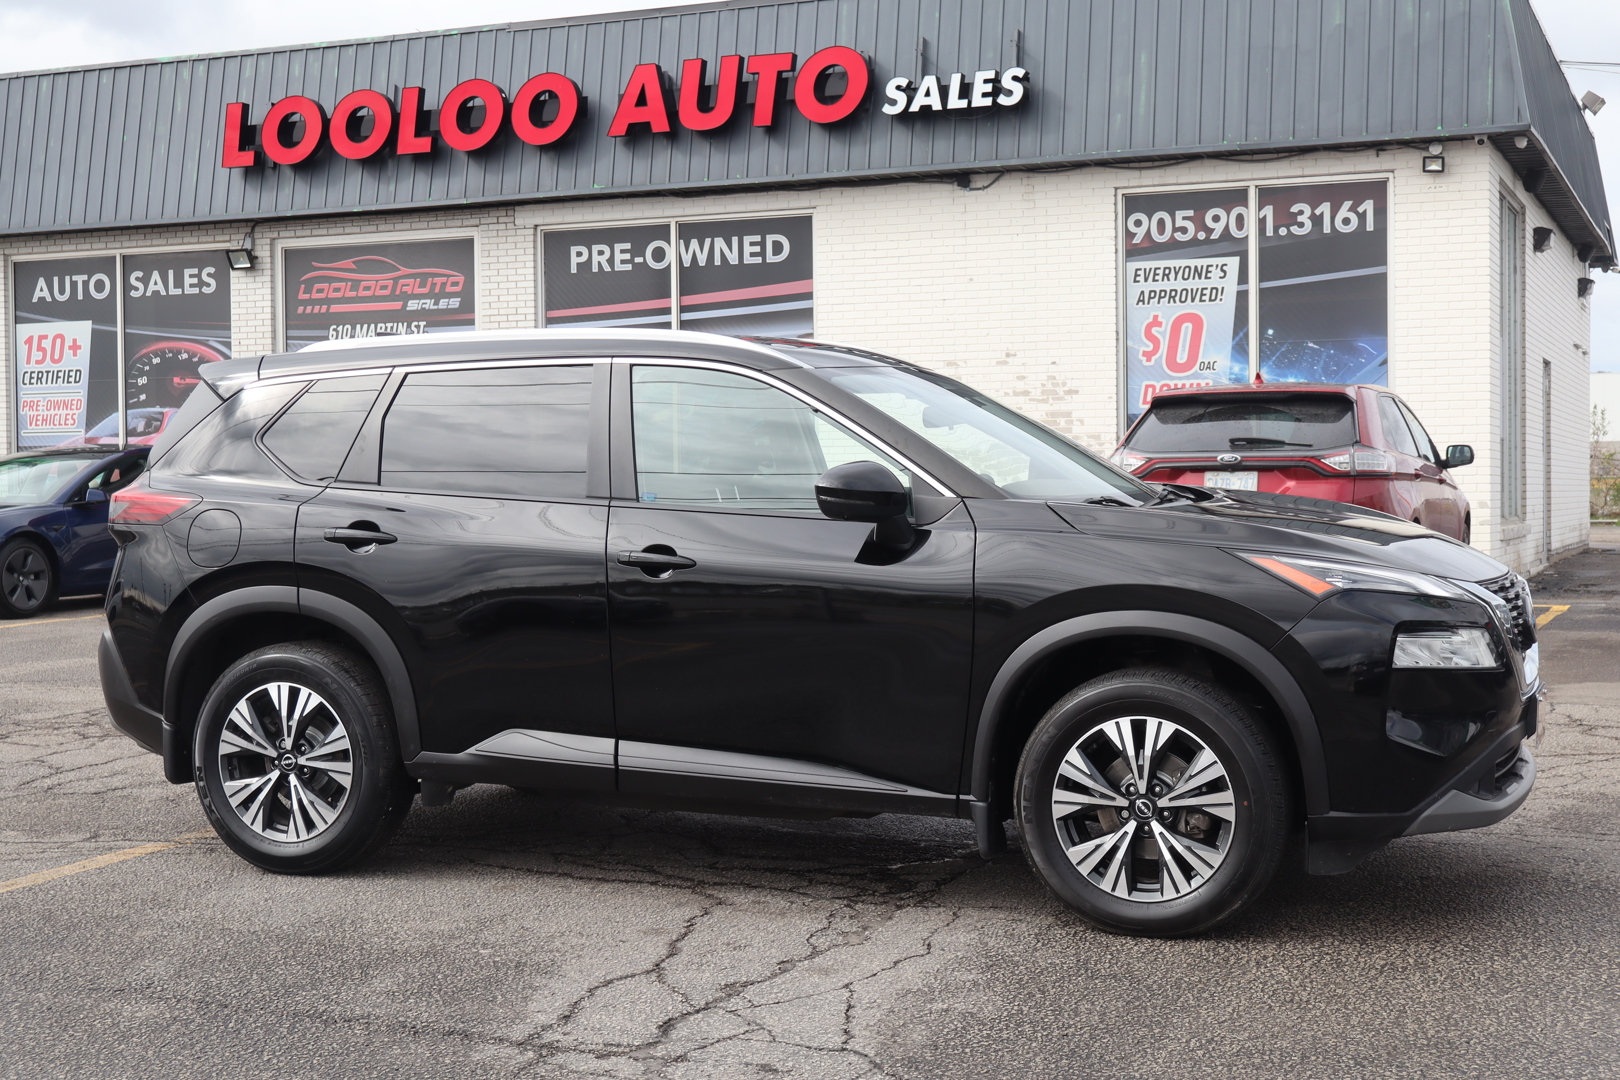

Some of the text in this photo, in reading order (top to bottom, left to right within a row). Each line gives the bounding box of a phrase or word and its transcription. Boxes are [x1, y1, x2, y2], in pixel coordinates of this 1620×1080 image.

[222, 45, 1029, 168] LOOLOO AUTO SALES
[1126, 199, 1375, 244] 905.901.3161
[570, 233, 791, 274] PRE-OWNED
[1132, 263, 1228, 284] EVERYONE'S
[32, 266, 217, 303] AUTO SALES
[298, 277, 465, 300] LOOLOO AUTO
[406, 297, 461, 311] SALES
[1135, 286, 1225, 306] APPROVED!
[328, 324, 352, 340] 610
[22, 333, 82, 366] 150+
[1141, 311, 1205, 374] $0
[1198, 360, 1218, 372] OAC
[21, 369, 82, 386] CERTIFIED
[137, 375, 148, 386] 50
[21, 398, 83, 413] PRE-OWNED
[27, 412, 77, 428] VEHICLES
